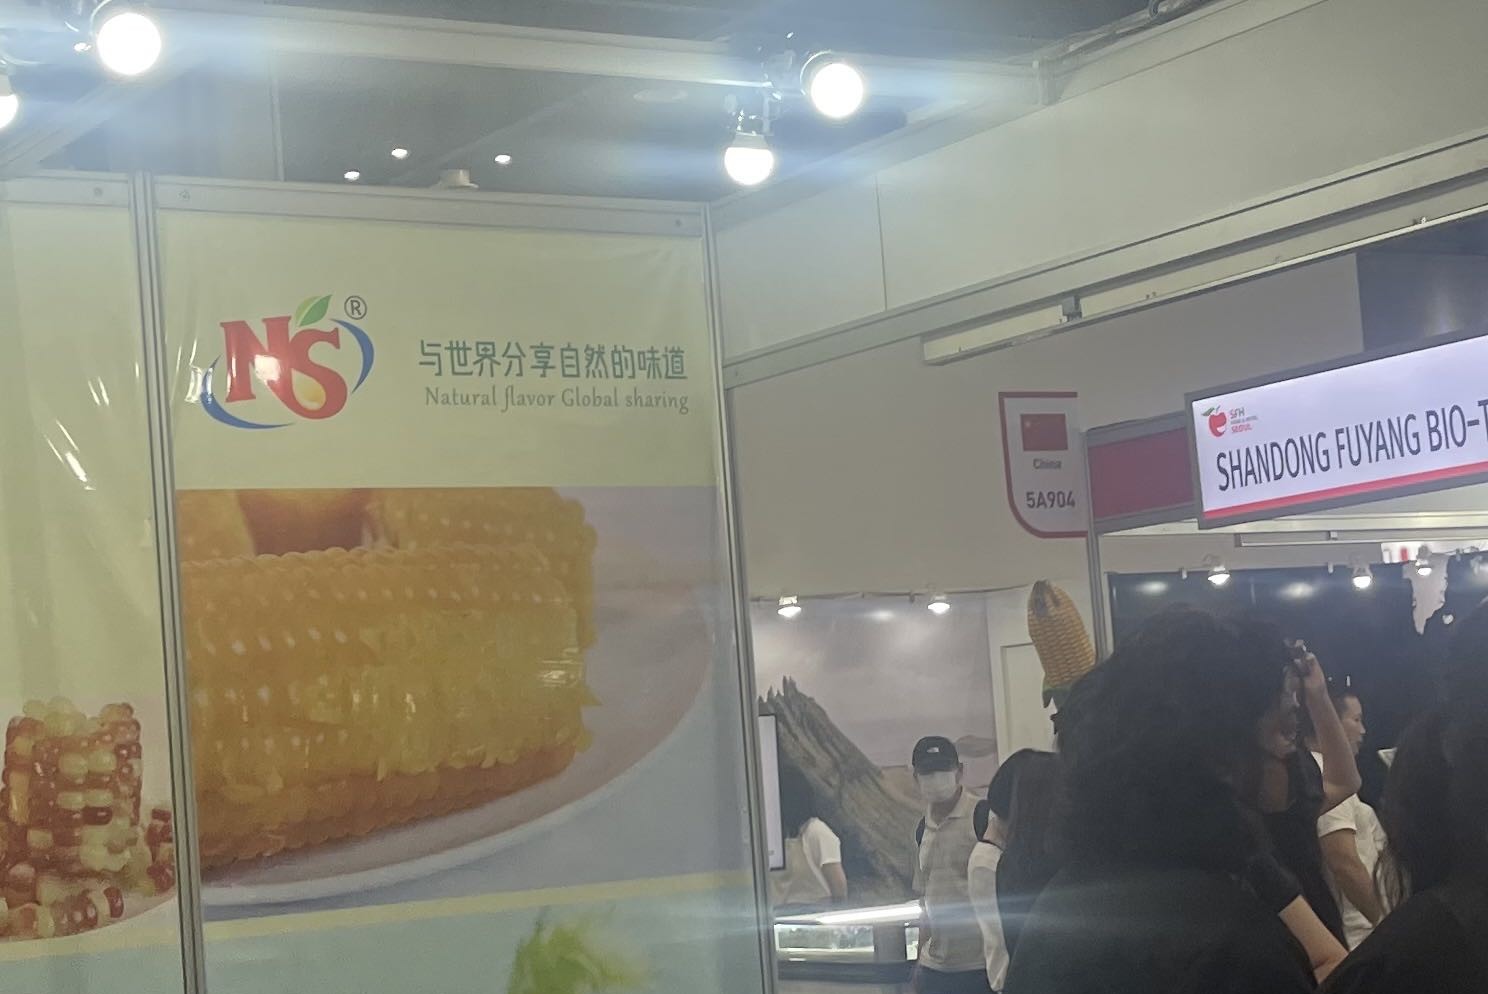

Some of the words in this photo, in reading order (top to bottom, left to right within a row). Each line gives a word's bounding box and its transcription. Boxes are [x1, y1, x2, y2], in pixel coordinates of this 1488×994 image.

[419, 340, 688, 379] 与世界分享自然的味道
[425, 386, 497, 406] Natural
[501, 385, 555, 413] flavor
[561, 386, 619, 408] Global
[625, 386, 689, 414] sharing
[1216, 431, 1331, 491] SHANDONG
[1335, 413, 1420, 469] FUYANG
[1026, 490, 1075, 509] 5A904
